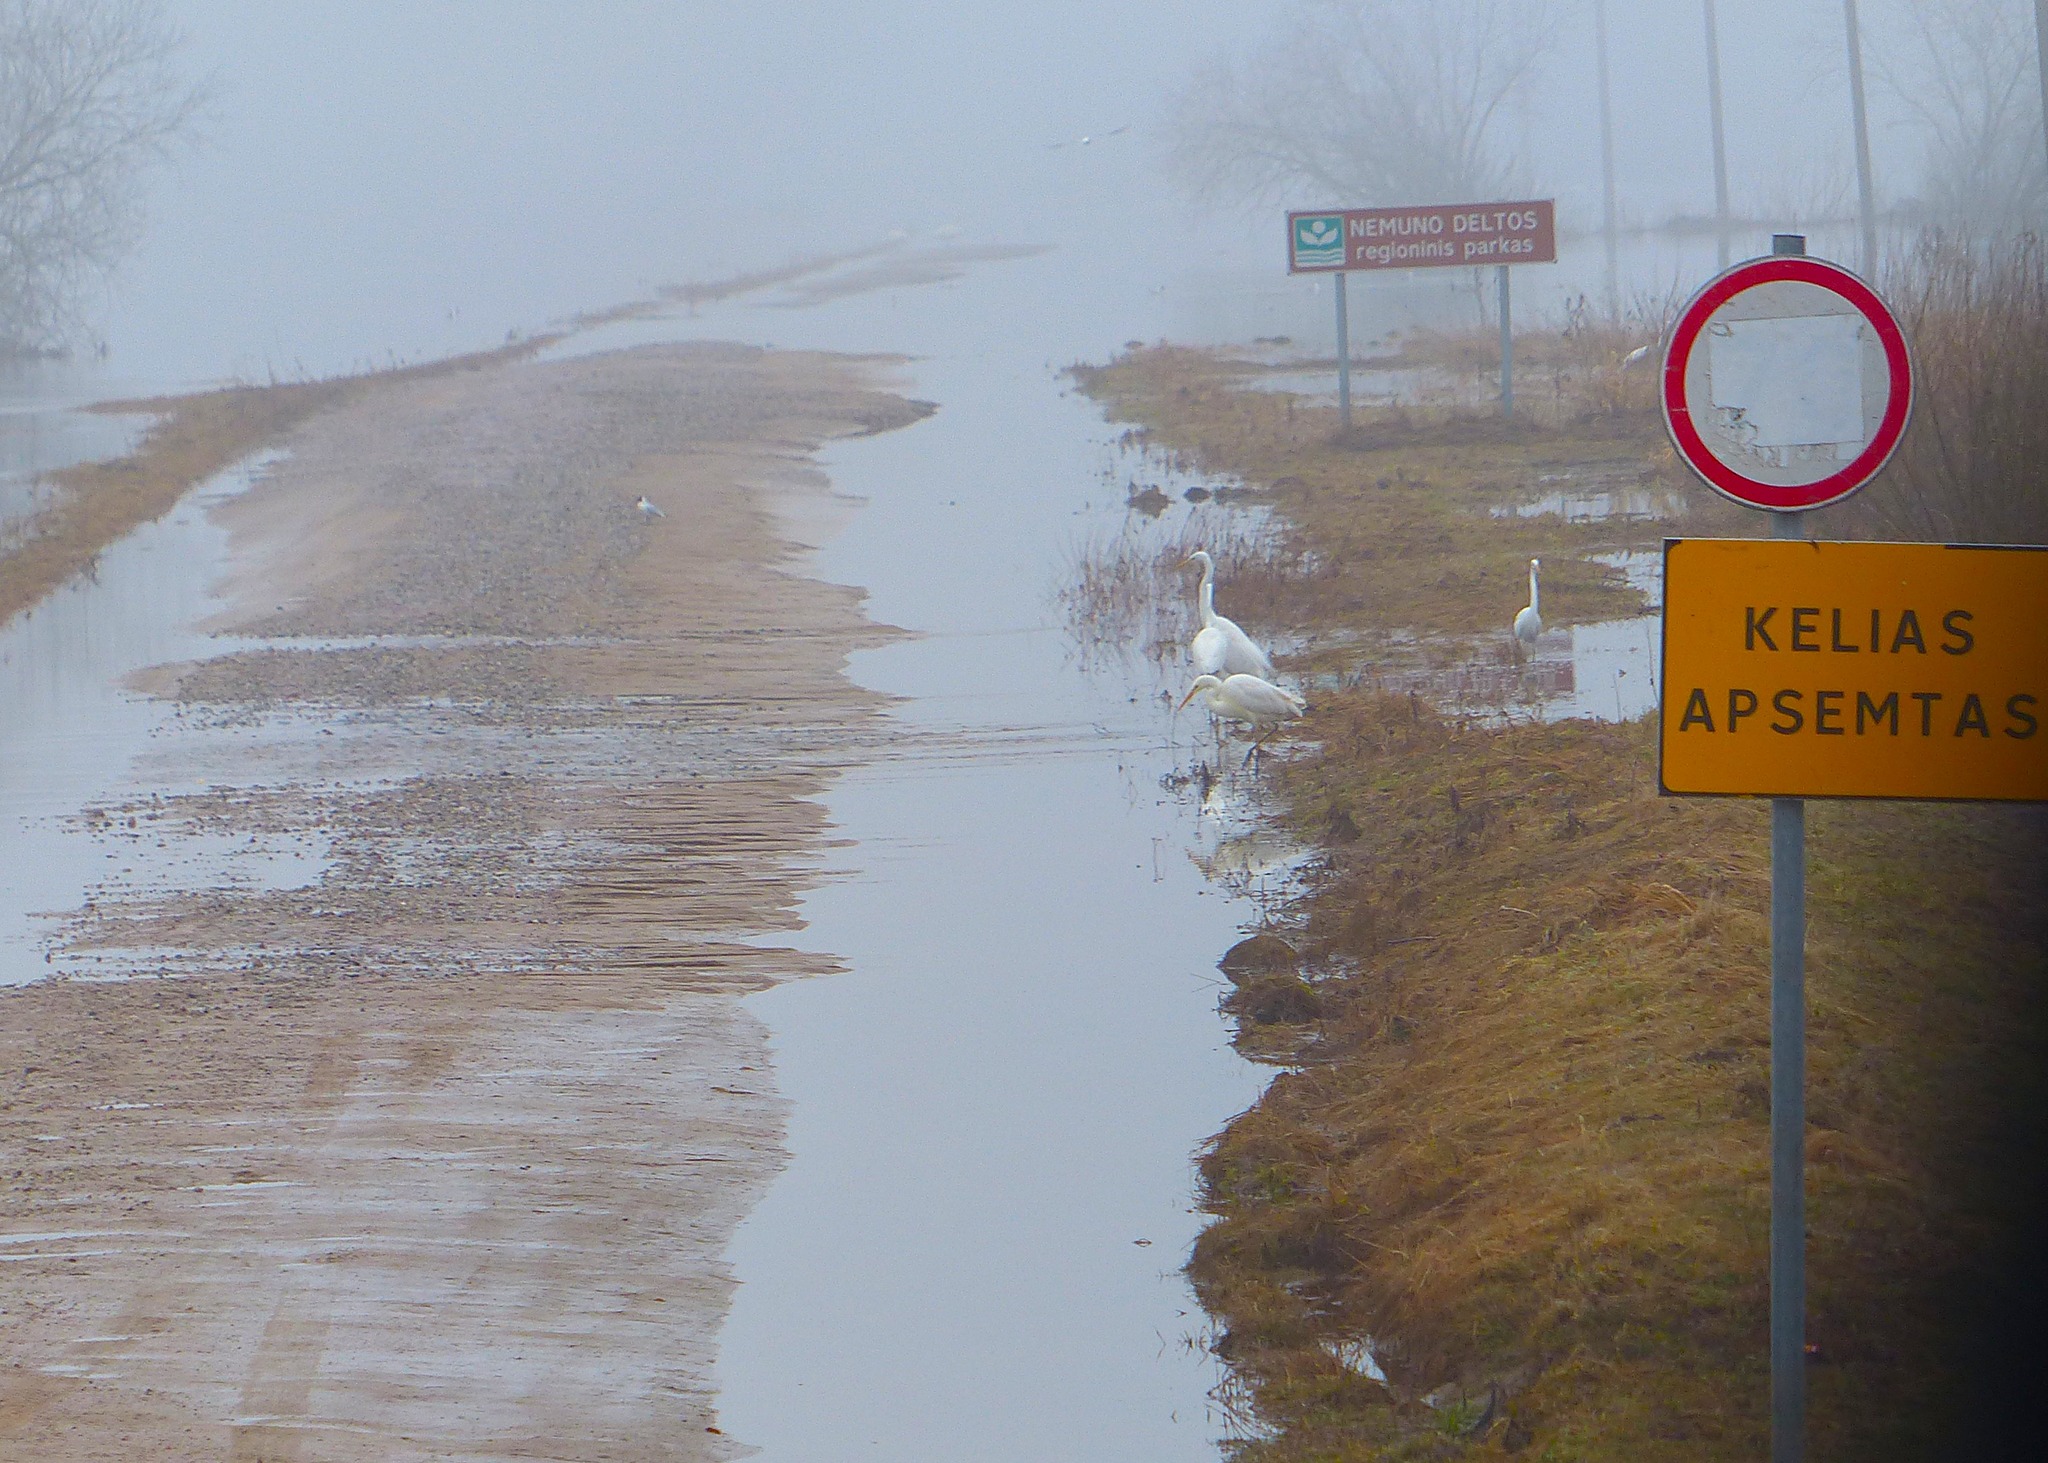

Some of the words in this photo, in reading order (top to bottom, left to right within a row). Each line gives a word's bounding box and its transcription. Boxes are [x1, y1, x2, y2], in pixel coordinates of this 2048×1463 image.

[1350, 215, 1444, 238] NEMUNO
[1453, 211, 1538, 233] DELTOS
[1356, 239, 1454, 264] regioninis
[1464, 236, 1533, 260] parkas
[1744, 606, 1975, 656] KELIAS
[1679, 688, 2039, 740] APSEMTAS
